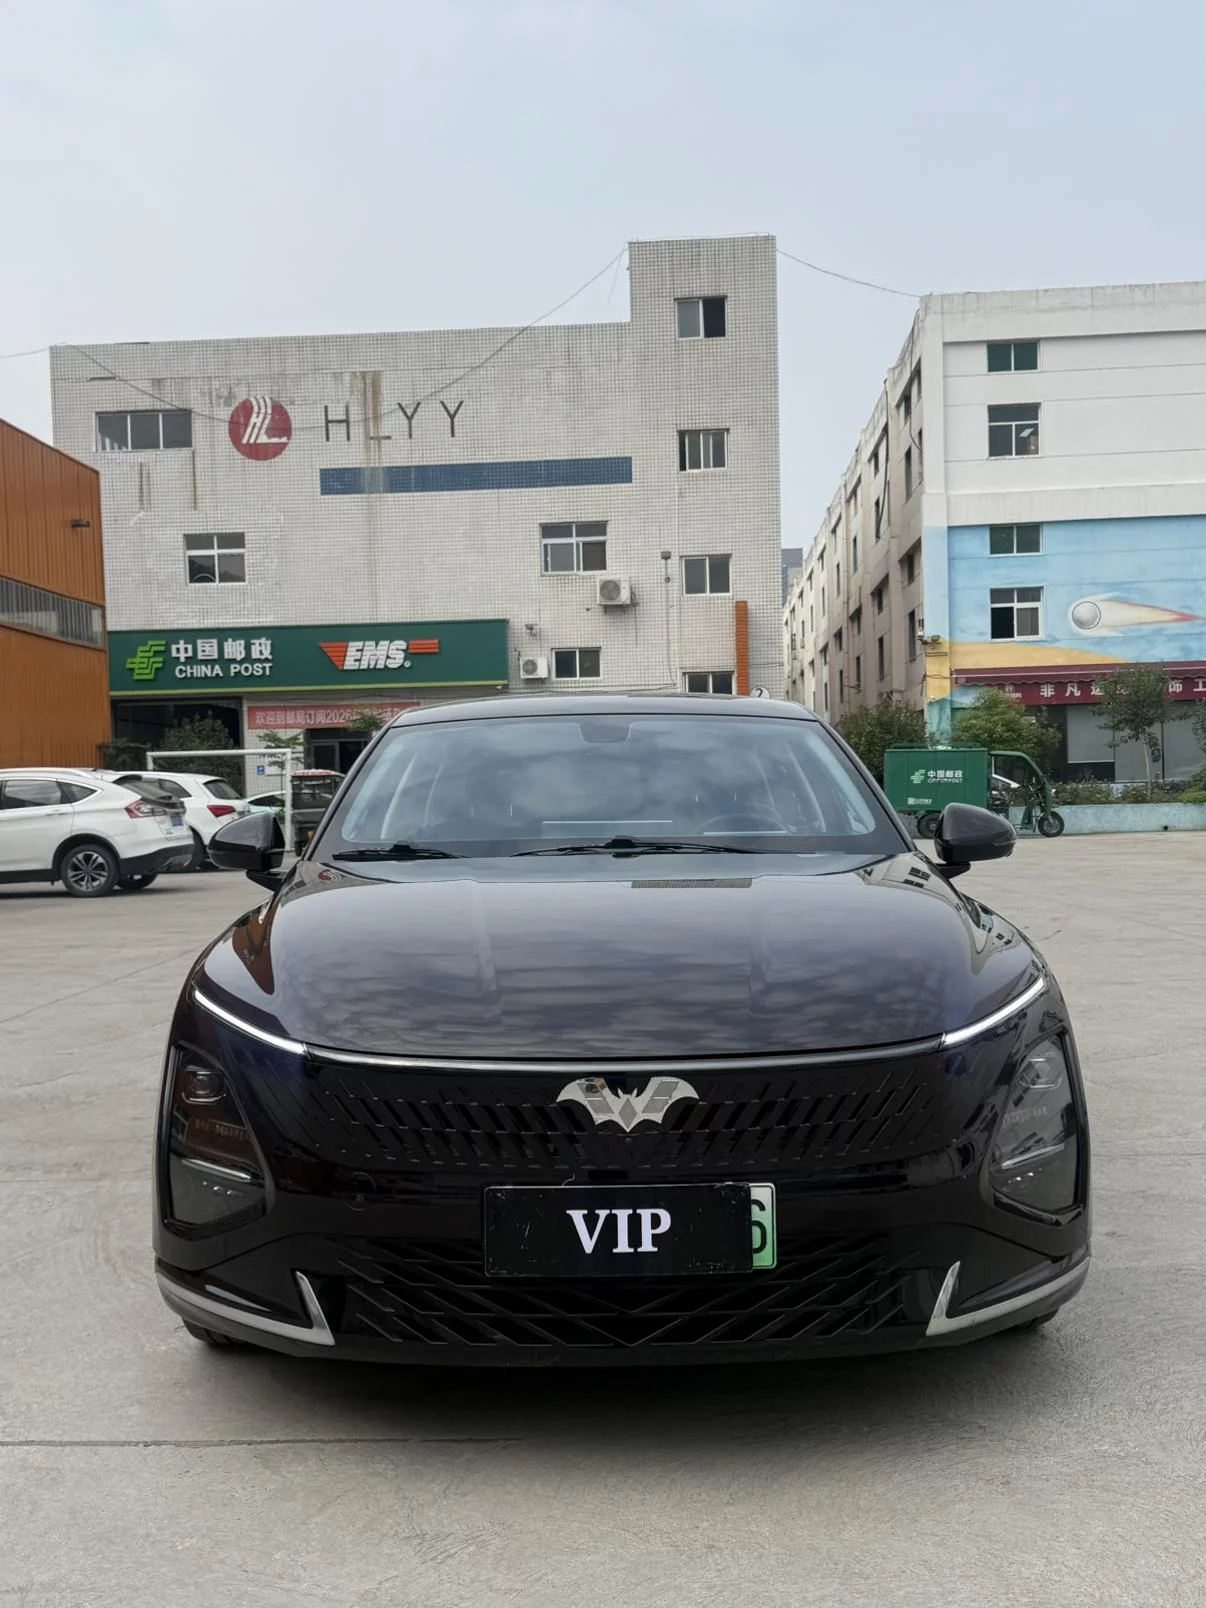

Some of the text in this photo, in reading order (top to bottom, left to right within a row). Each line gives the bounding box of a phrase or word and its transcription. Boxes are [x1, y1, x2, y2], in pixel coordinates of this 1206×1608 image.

[170, 637, 273, 663] 中国邮政
[343, 640, 408, 670] EMS
[174, 663, 273, 679] CHINA POST
[566, 1208, 671, 1254] VIP
